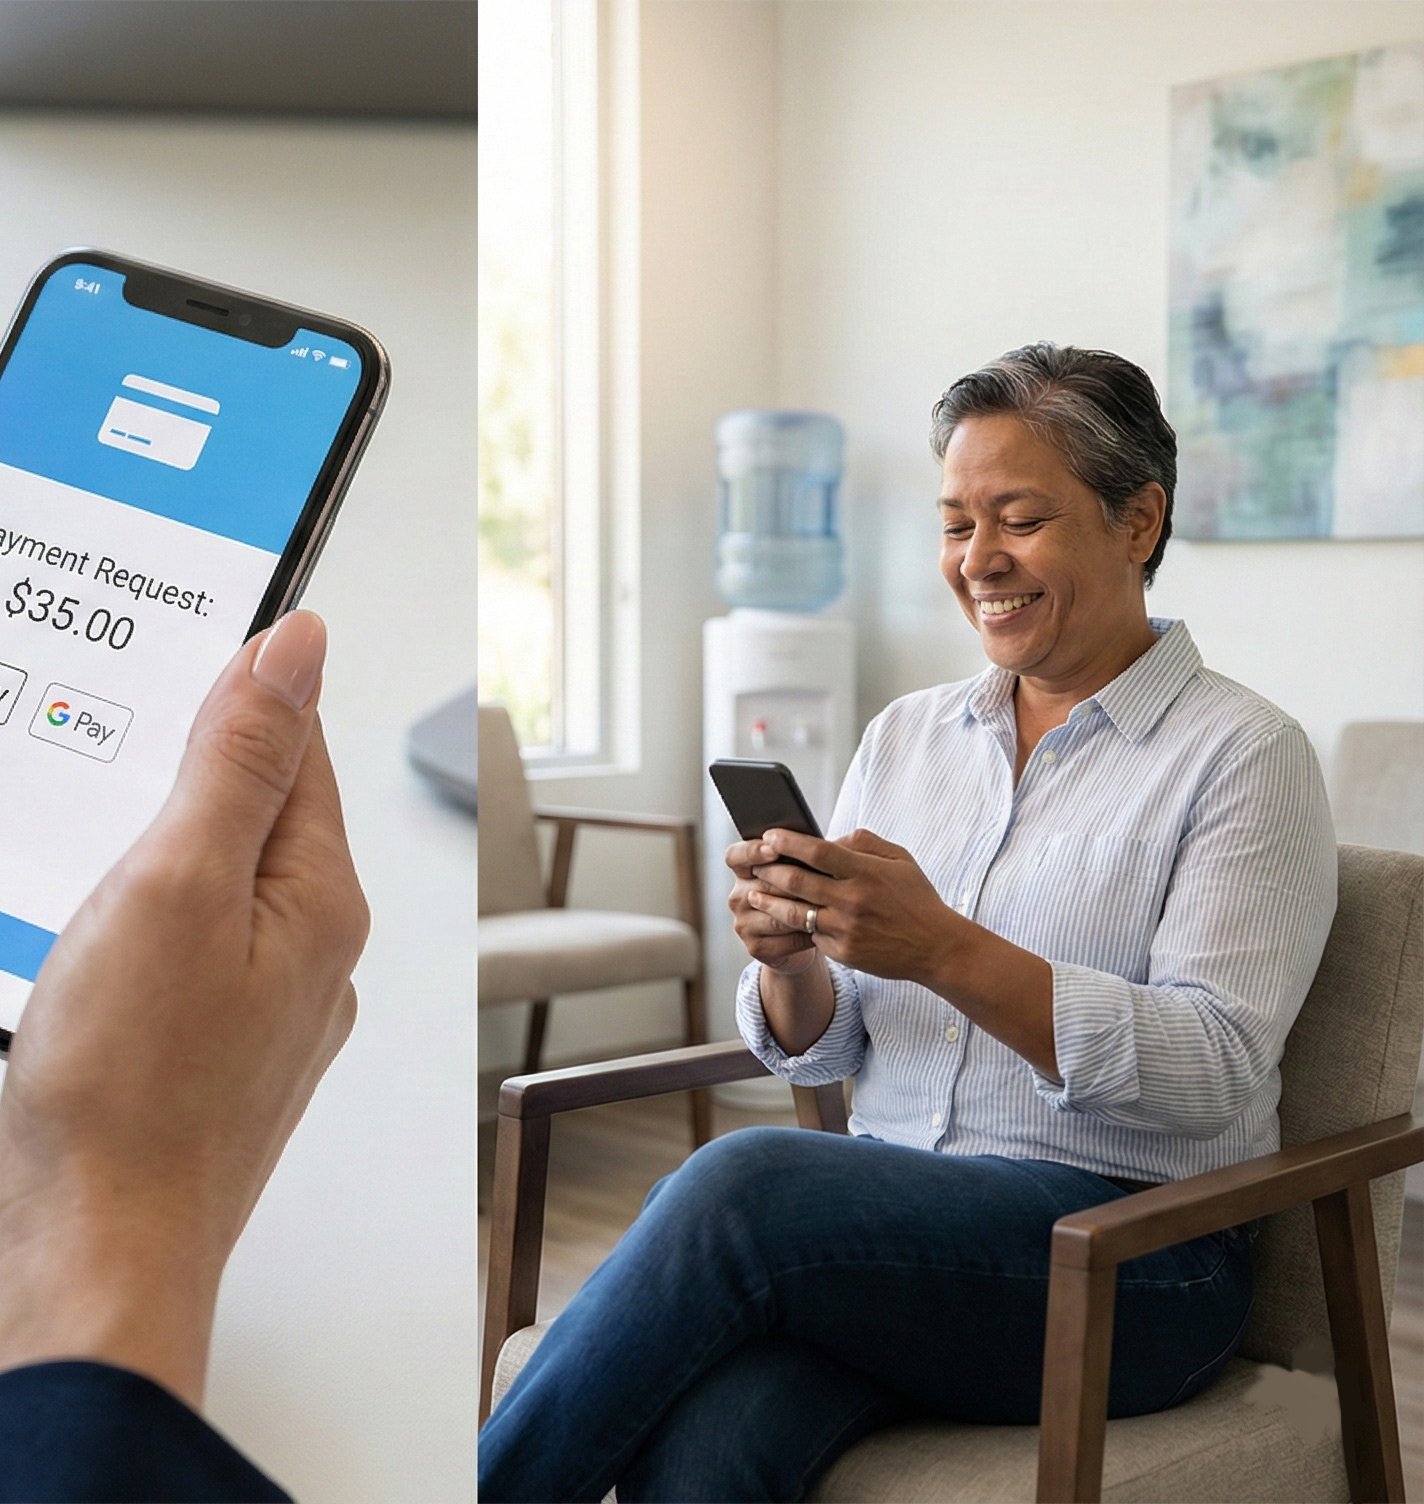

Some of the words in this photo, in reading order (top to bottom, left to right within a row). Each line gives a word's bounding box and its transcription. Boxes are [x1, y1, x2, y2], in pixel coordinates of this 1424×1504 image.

[5, 577, 135, 650] $35.00
[93, 556, 214, 616] Request:
[46, 701, 71, 726] G
[73, 711, 116, 746] Pay
